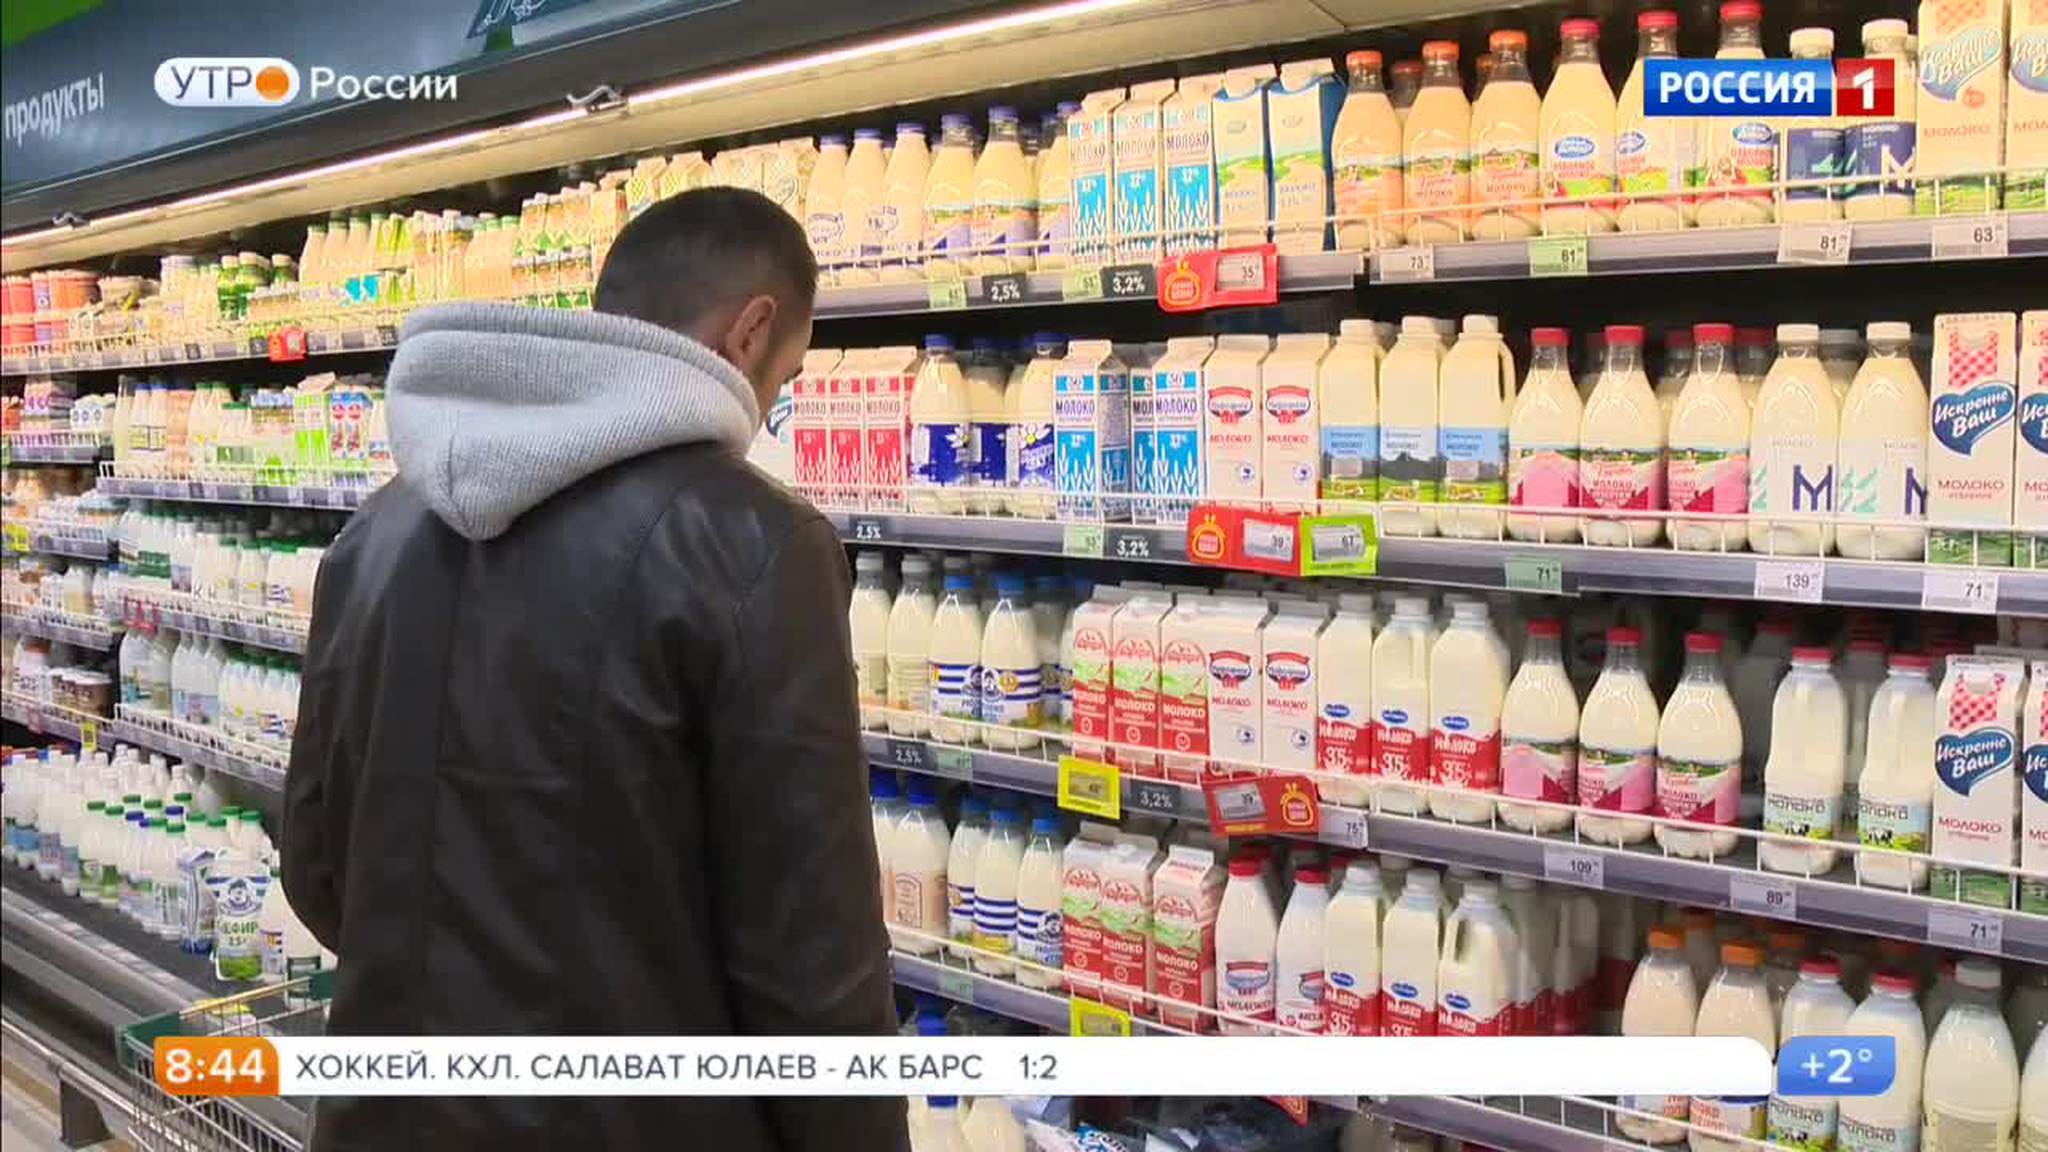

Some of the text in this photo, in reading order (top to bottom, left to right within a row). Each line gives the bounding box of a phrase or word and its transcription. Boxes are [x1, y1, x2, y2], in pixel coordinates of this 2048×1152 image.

[4, 72, 105, 148] продукты
[1166, 131, 1210, 150] МОЛОКО
[1820, 236, 1837, 251] 81
[991, 282, 1022, 301] 2,5%
[1112, 276, 1146, 294] 3,2%
[1056, 401, 1095, 415] МОЛОКО
[1156, 399, 1198, 414] МОЛОКО
[1935, 388, 2008, 423] Искренне
[1952, 409, 1998, 438] Ваш
[1937, 479, 2006, 492] МОЛОКО
[1116, 539, 1150, 558] 3,2%
[1536, 566, 1551, 581] 71
[1785, 574, 1810, 589] 139
[1965, 583, 1984, 599] 71
[1937, 737, 2007, 763] Искренне
[1952, 752, 1996, 778] Ваш
[1140, 791, 1173, 809] 3,2%
[1938, 817, 2003, 834] МОЛОКО
[1571, 859, 1593, 873] 109
[1766, 890, 1784, 905] 89
[1970, 923, 1988, 939] 71
